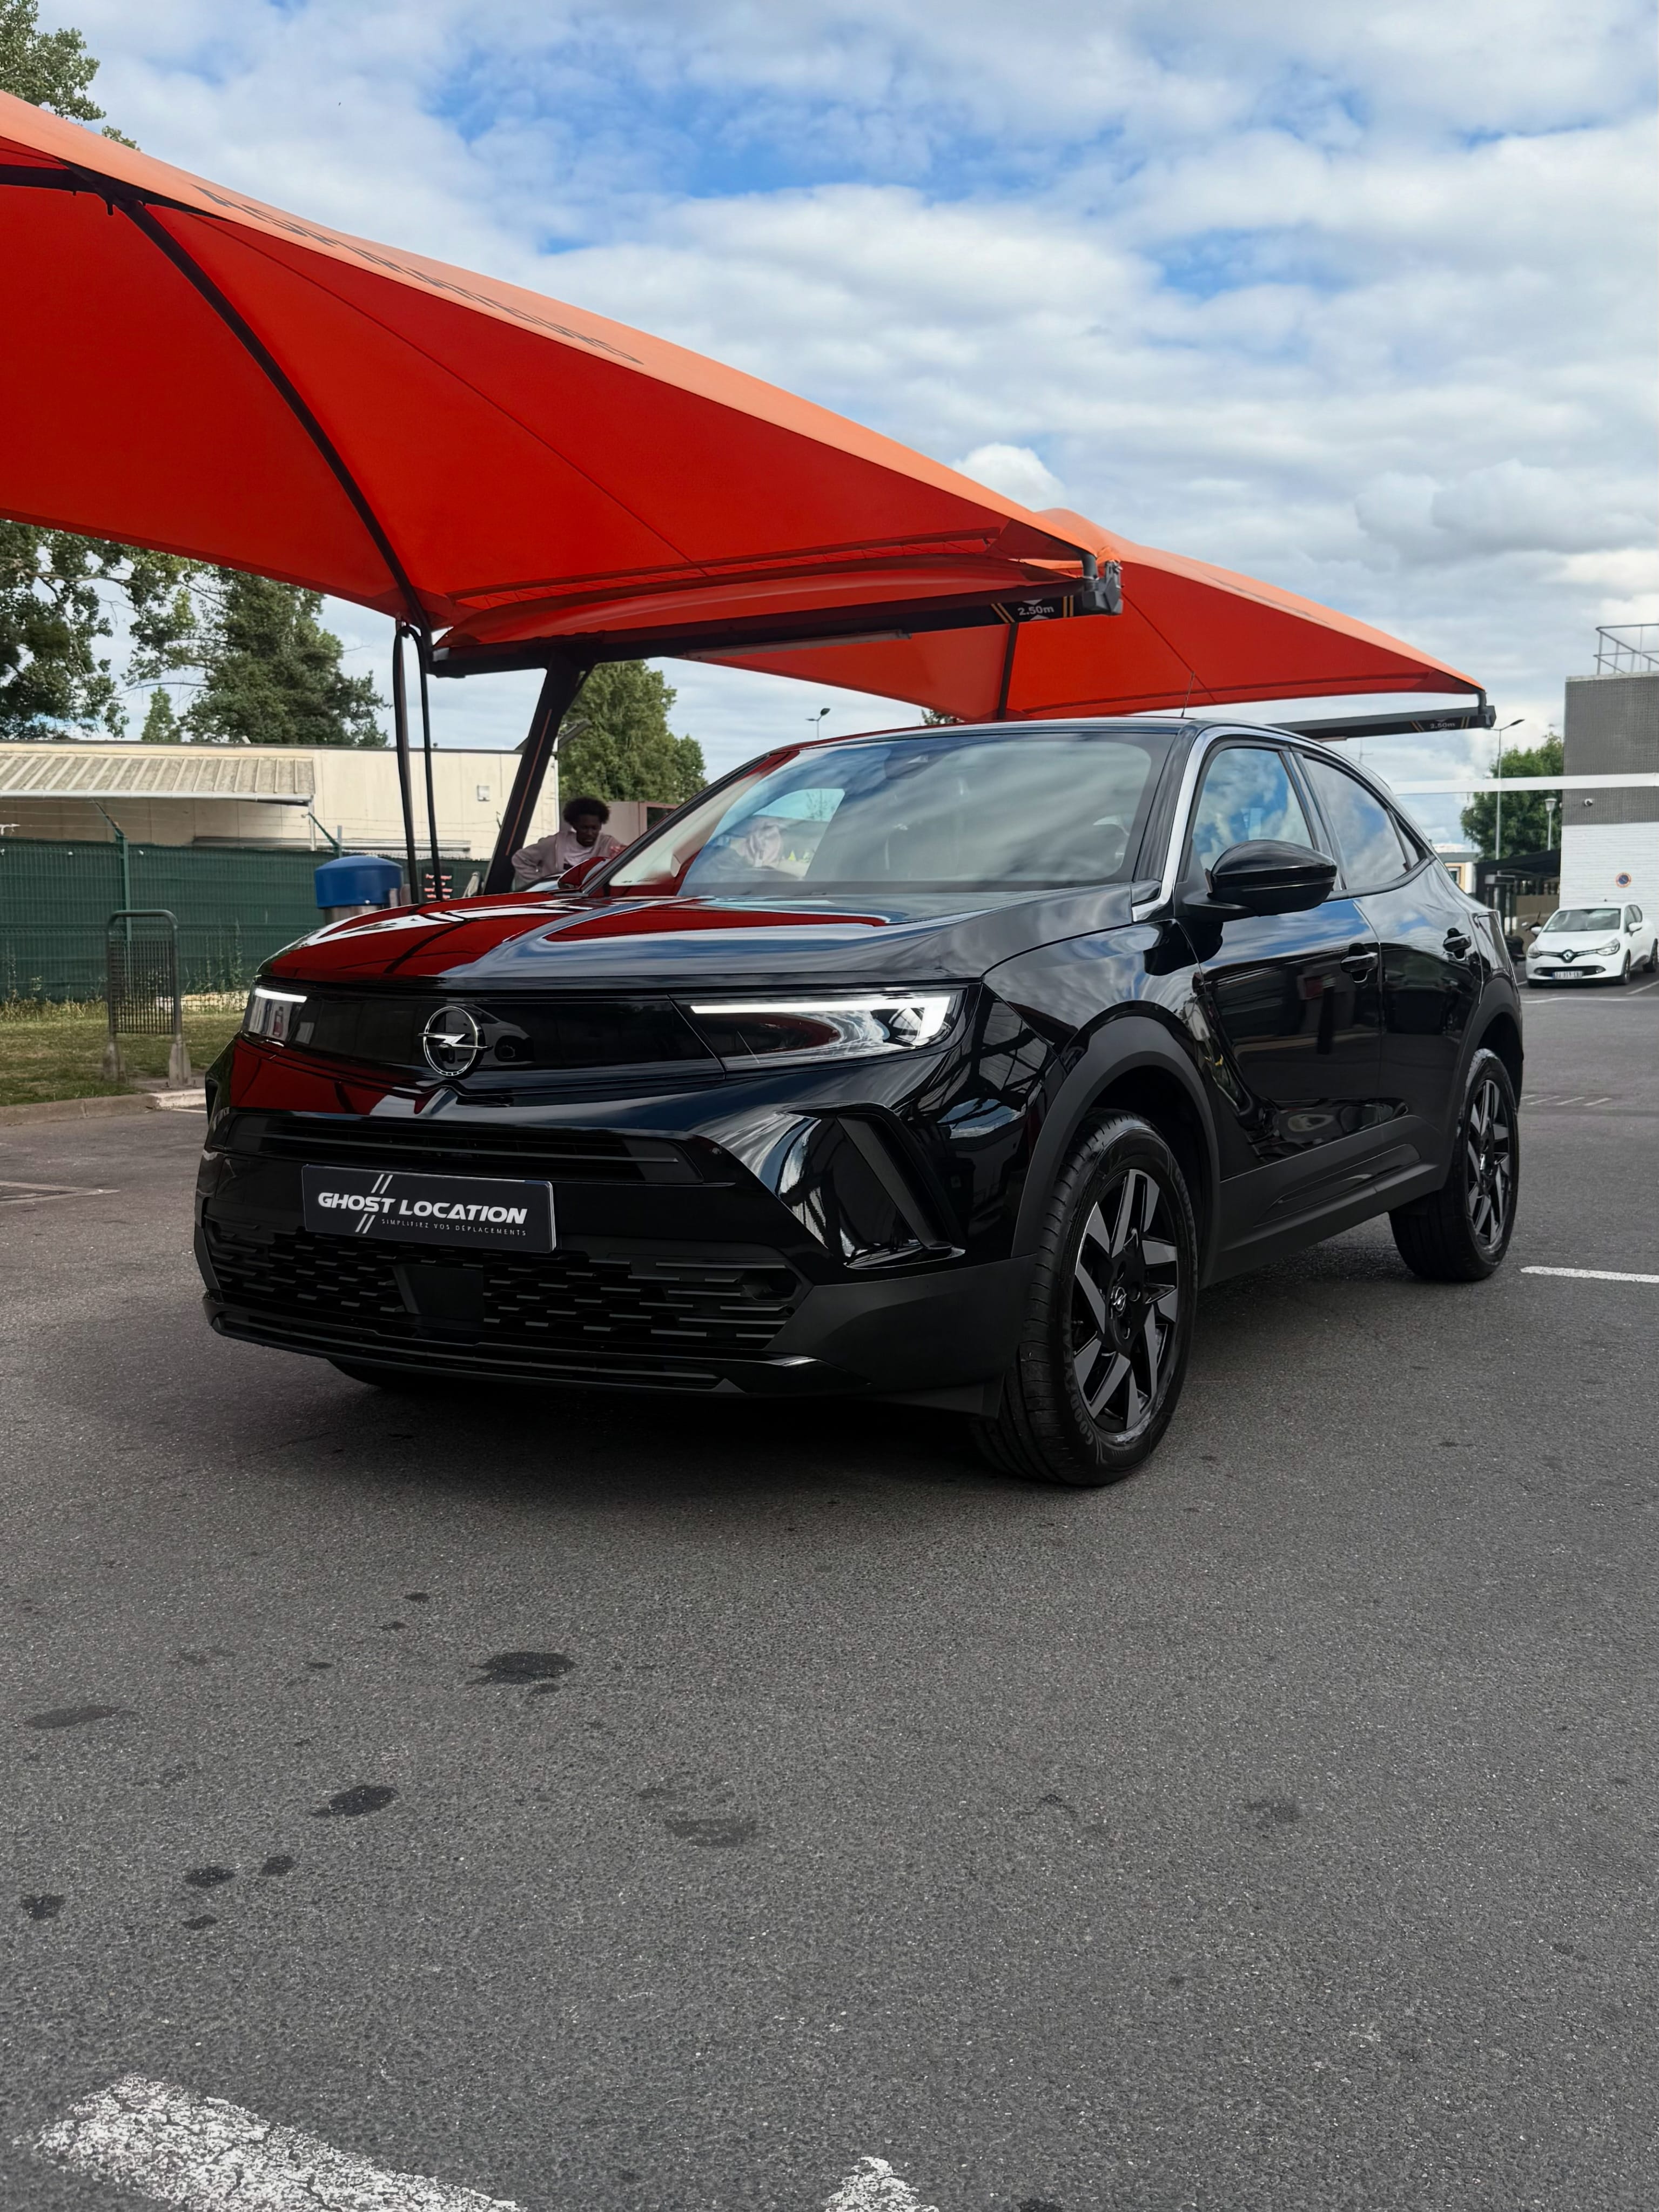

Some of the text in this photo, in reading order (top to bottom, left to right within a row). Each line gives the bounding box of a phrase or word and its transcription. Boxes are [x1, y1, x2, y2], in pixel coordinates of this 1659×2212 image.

[190, 184, 644, 365] ASPIRATEURS
[1017, 606, 1054, 615] 2.50m
[318, 1192, 527, 1224] GHOST LOCATION
[455, 1225, 526, 1236] DÉPLACEMENTS
